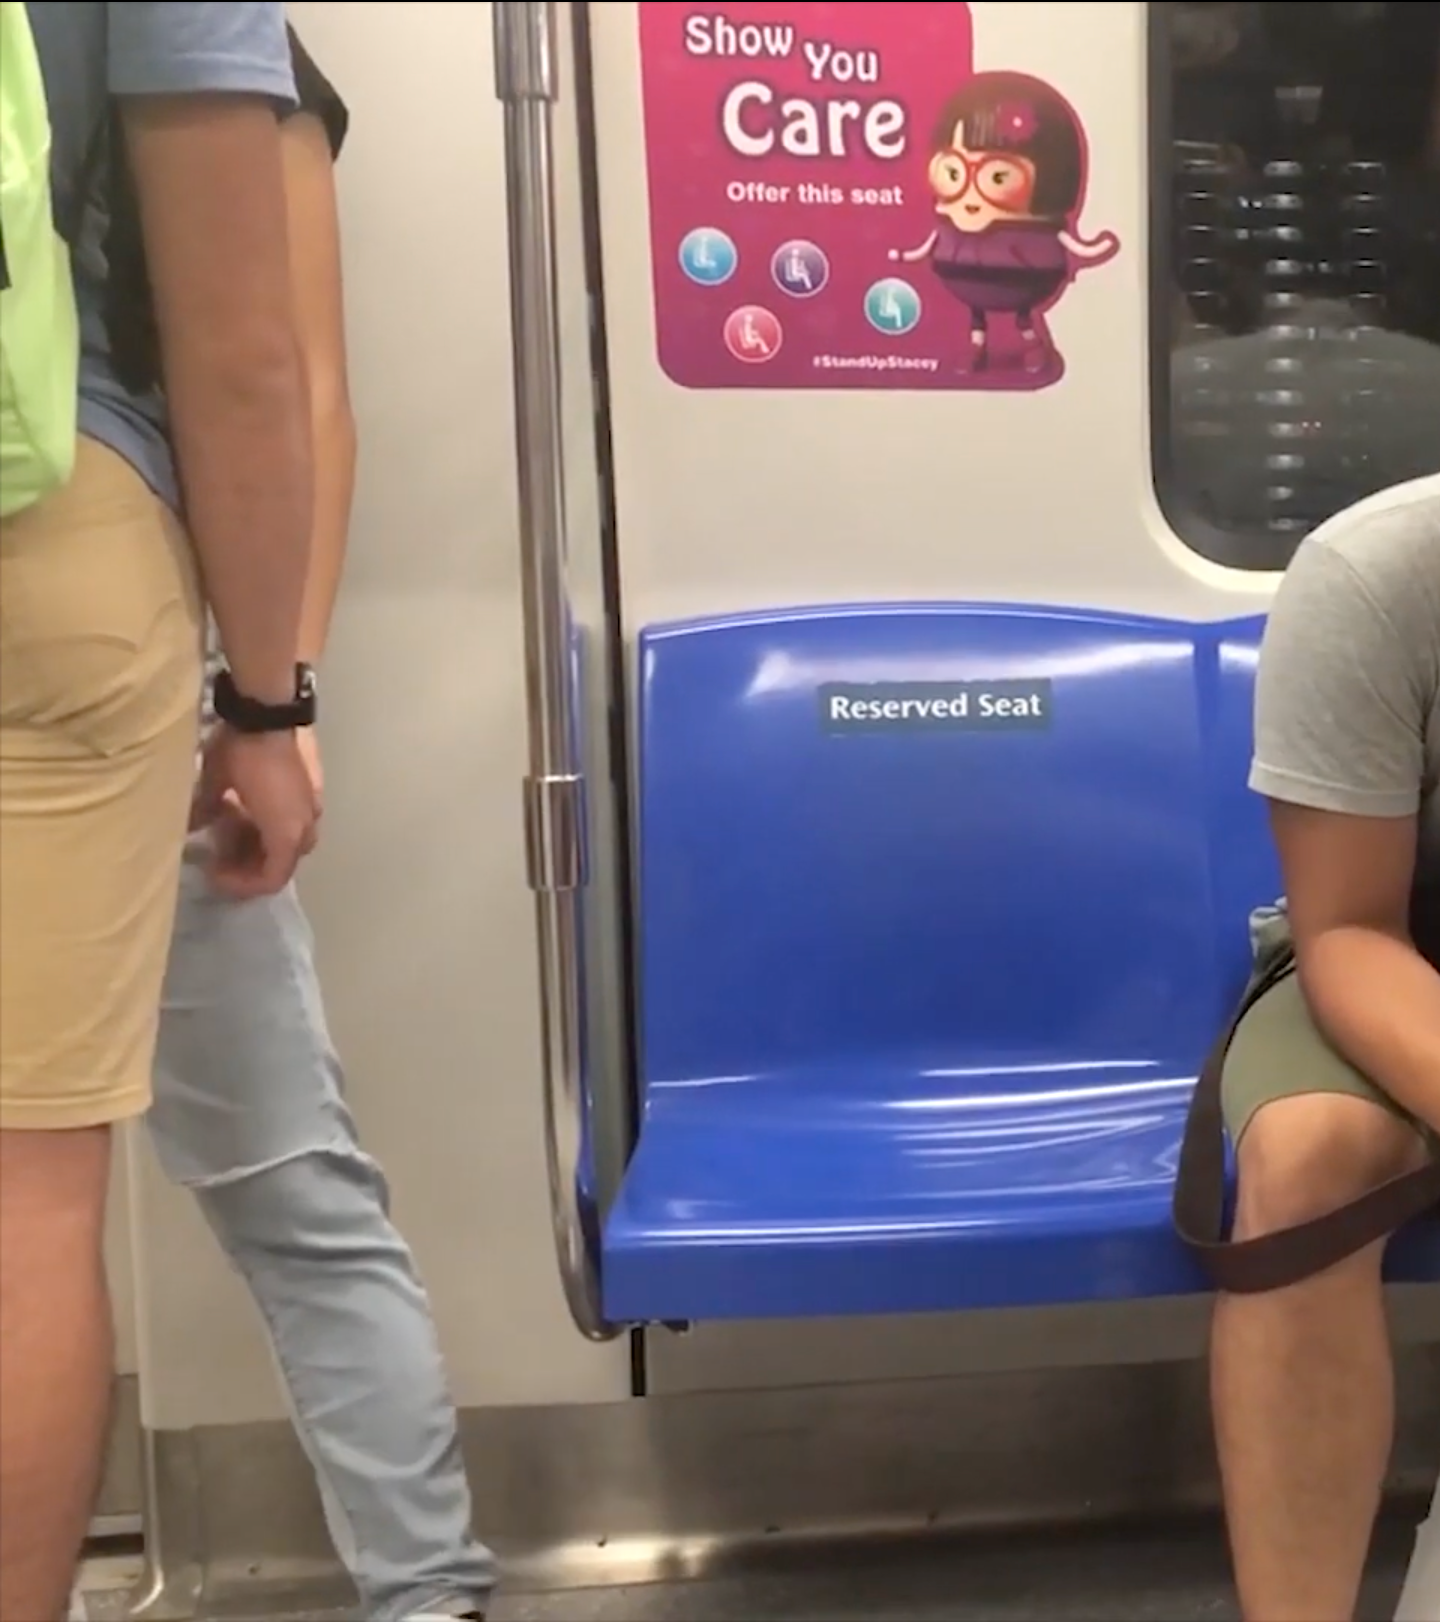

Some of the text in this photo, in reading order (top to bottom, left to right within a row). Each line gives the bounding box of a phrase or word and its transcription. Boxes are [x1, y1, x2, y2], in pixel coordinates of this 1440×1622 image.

[686, 15, 877, 82] Show You
[723, 81, 905, 158] Care
[727, 181, 904, 205] Offer this seat
[813, 354, 939, 372] #StandUpStacey
[830, 692, 1042, 720] Reserved Seat
